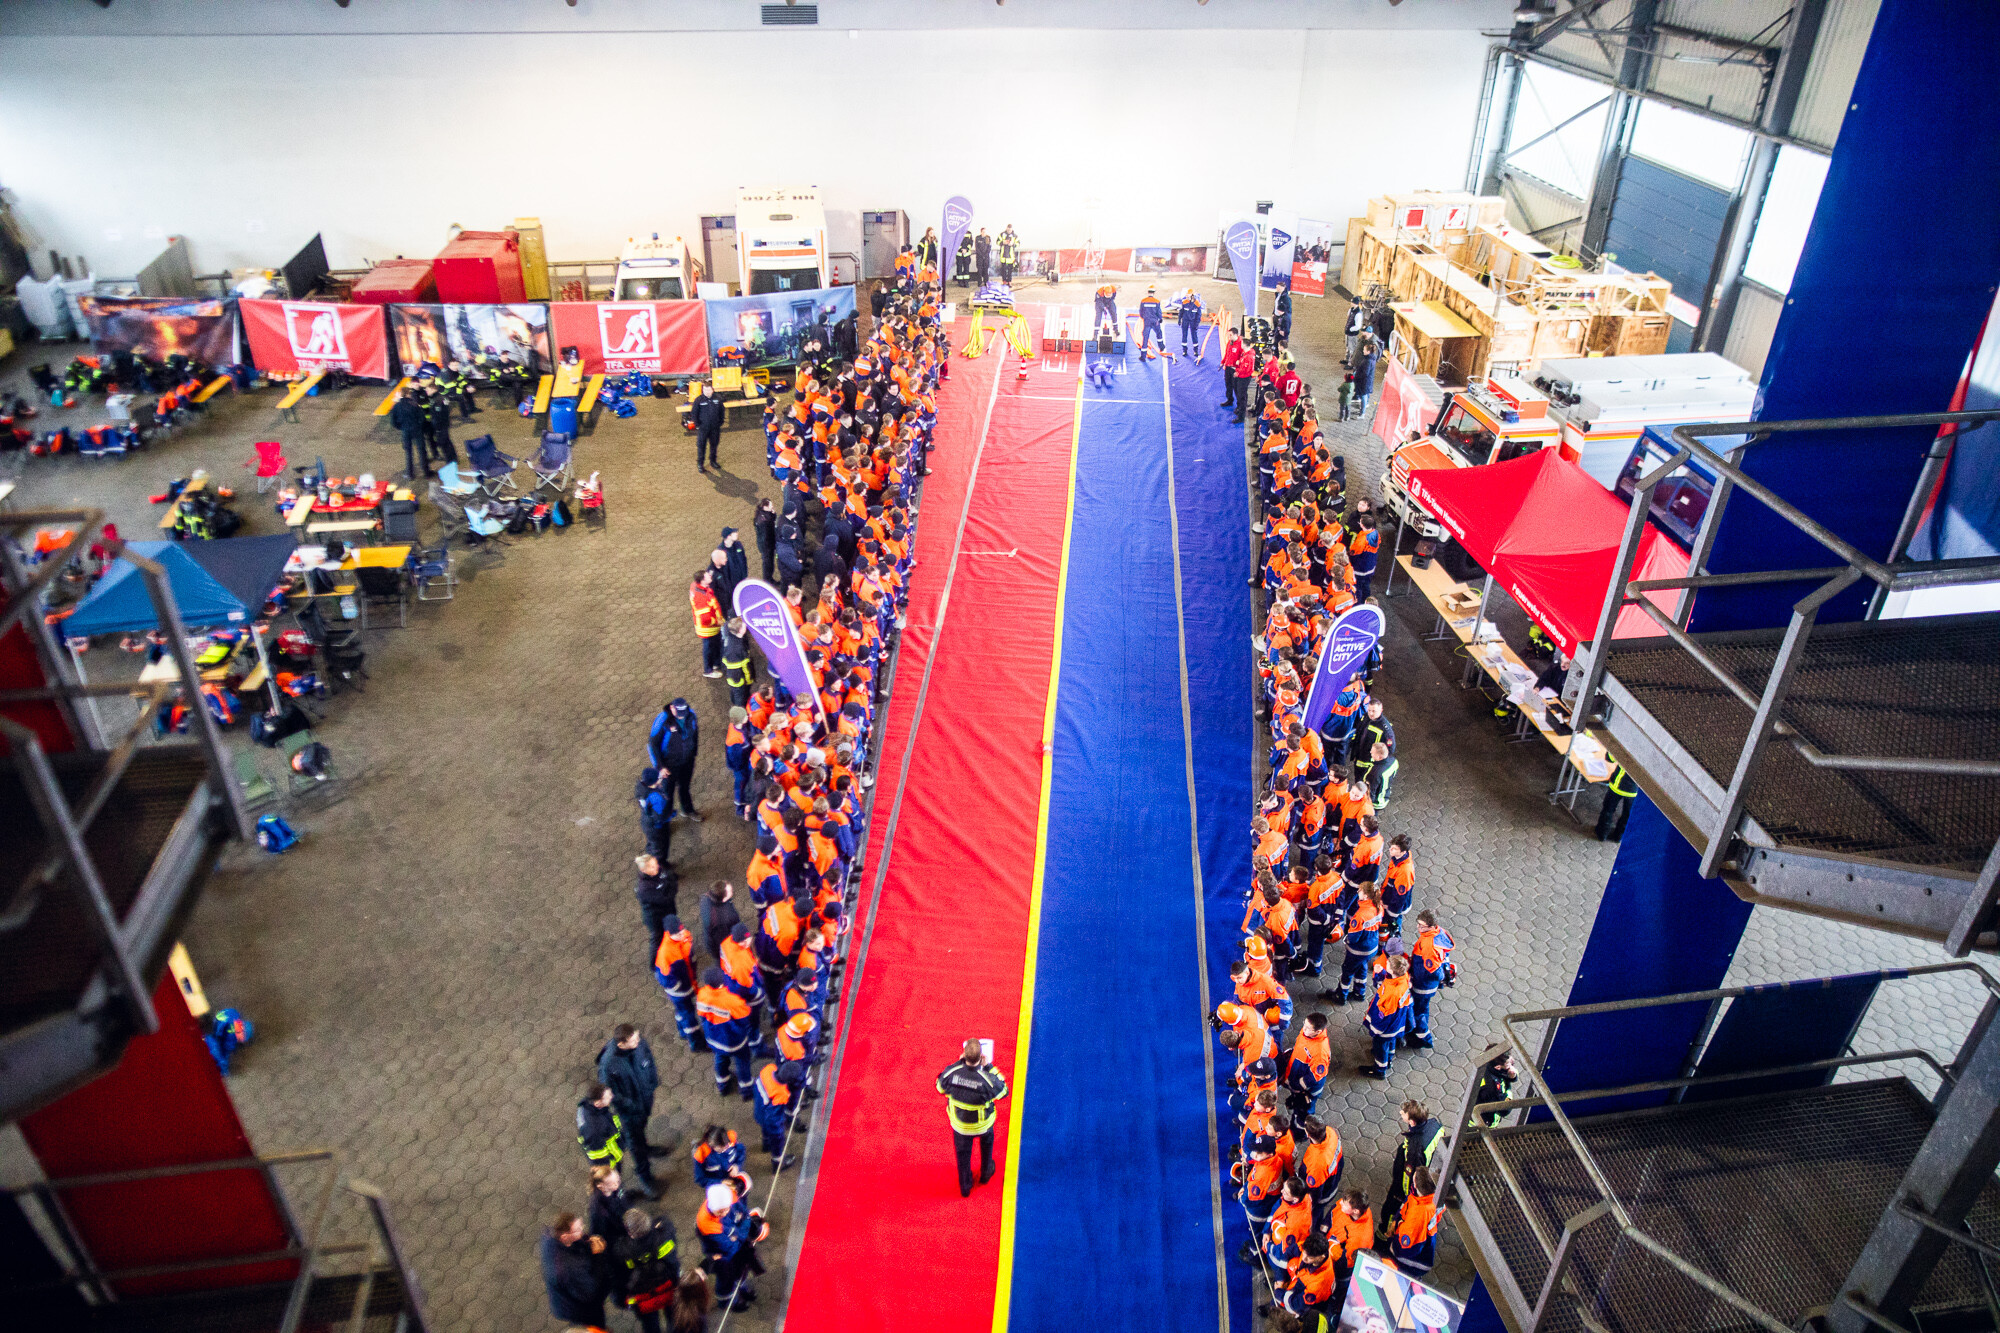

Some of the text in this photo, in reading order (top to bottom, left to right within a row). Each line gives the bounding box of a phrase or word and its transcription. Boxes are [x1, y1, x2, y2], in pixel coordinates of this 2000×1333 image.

[948, 214, 967, 222] ACTIVE
[631, 360, 661, 370] TEAM
[1442, 511, 1466, 540] Hamburg
[1511, 583, 1567, 648] Feuerwehr Hamburg
[1334, 643, 1366, 653] ACTIVE
[1333, 652, 1353, 662] CITY
